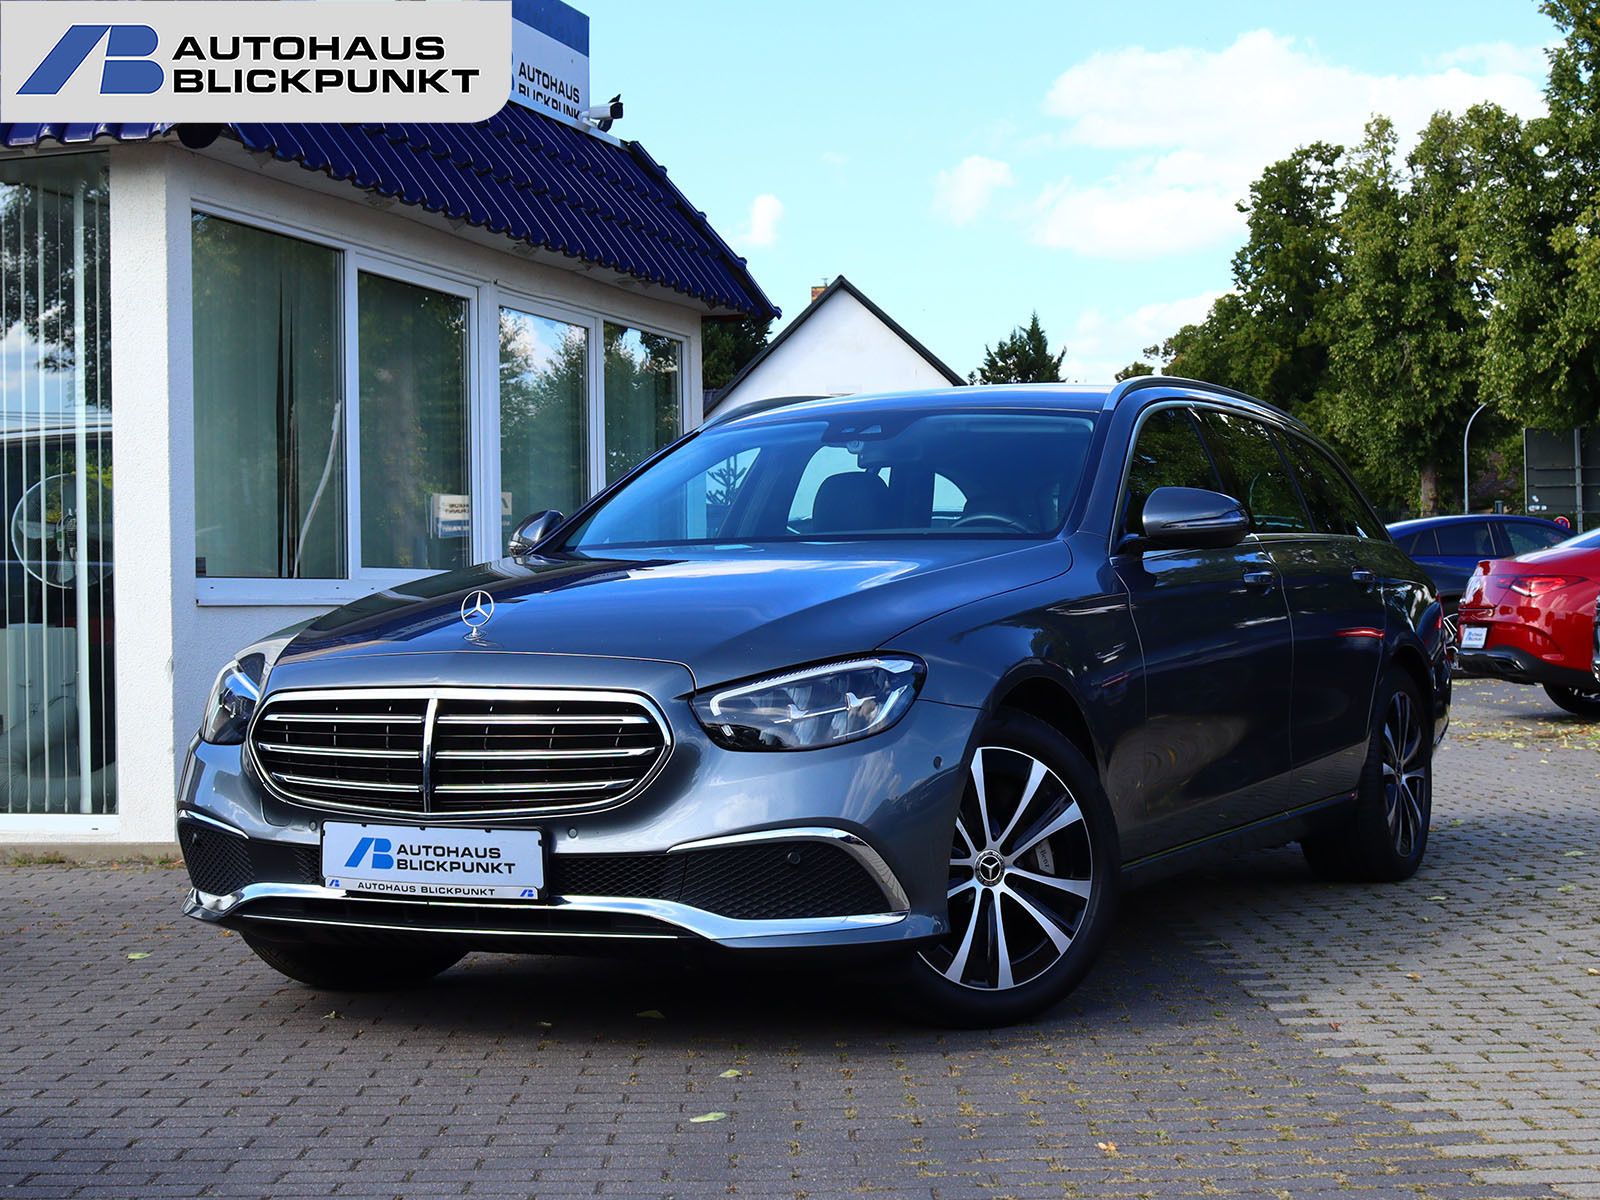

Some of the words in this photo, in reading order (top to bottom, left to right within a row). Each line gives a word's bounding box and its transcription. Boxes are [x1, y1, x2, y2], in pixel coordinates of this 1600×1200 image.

[518, 61, 580, 104] AUTOHAUS
[396, 844, 501, 859] AUTOHAUS
[396, 859, 516, 875] BLICKPUNKT
[357, 882, 417, 893] AUTOHAUS
[420, 886, 496, 896] BLICKPUNKT
